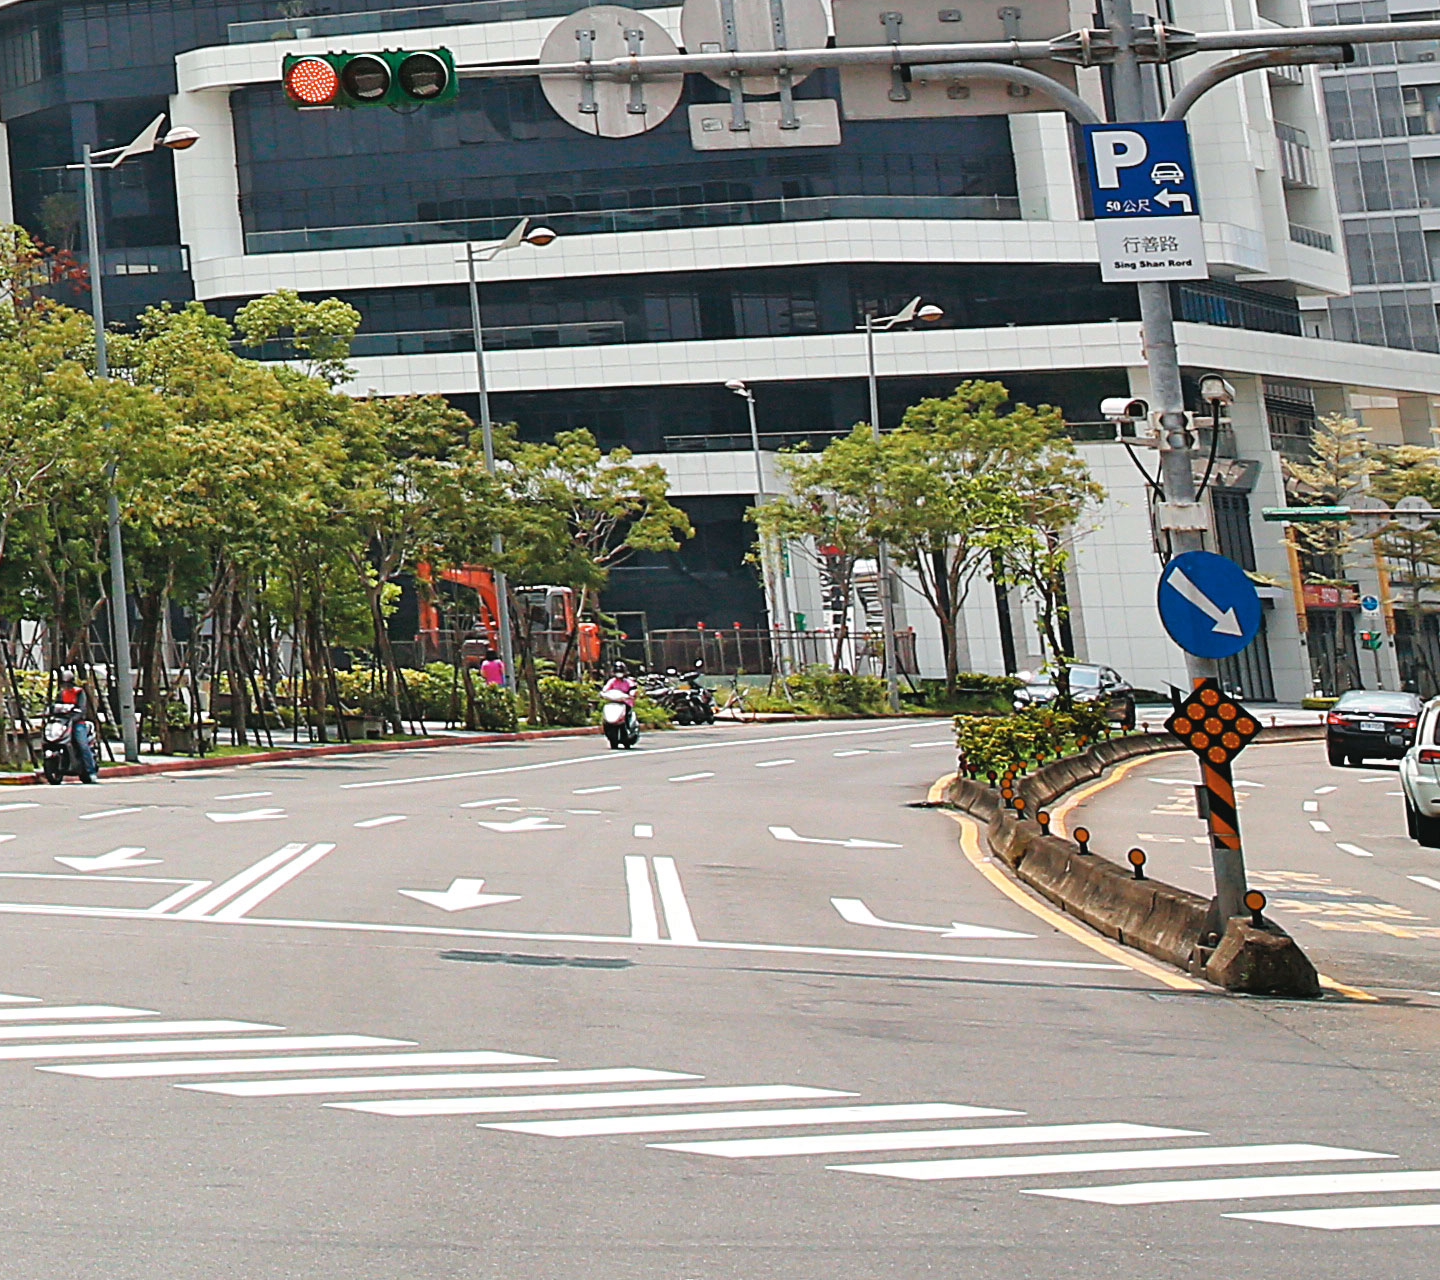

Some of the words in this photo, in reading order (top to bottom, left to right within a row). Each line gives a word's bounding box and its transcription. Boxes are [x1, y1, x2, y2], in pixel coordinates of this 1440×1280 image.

[1091, 130, 1148, 189] P
[1123, 235, 1179, 253] 行善路
[1114, 261, 1137, 270] Sing
[1140, 260, 1165, 268] Shan
